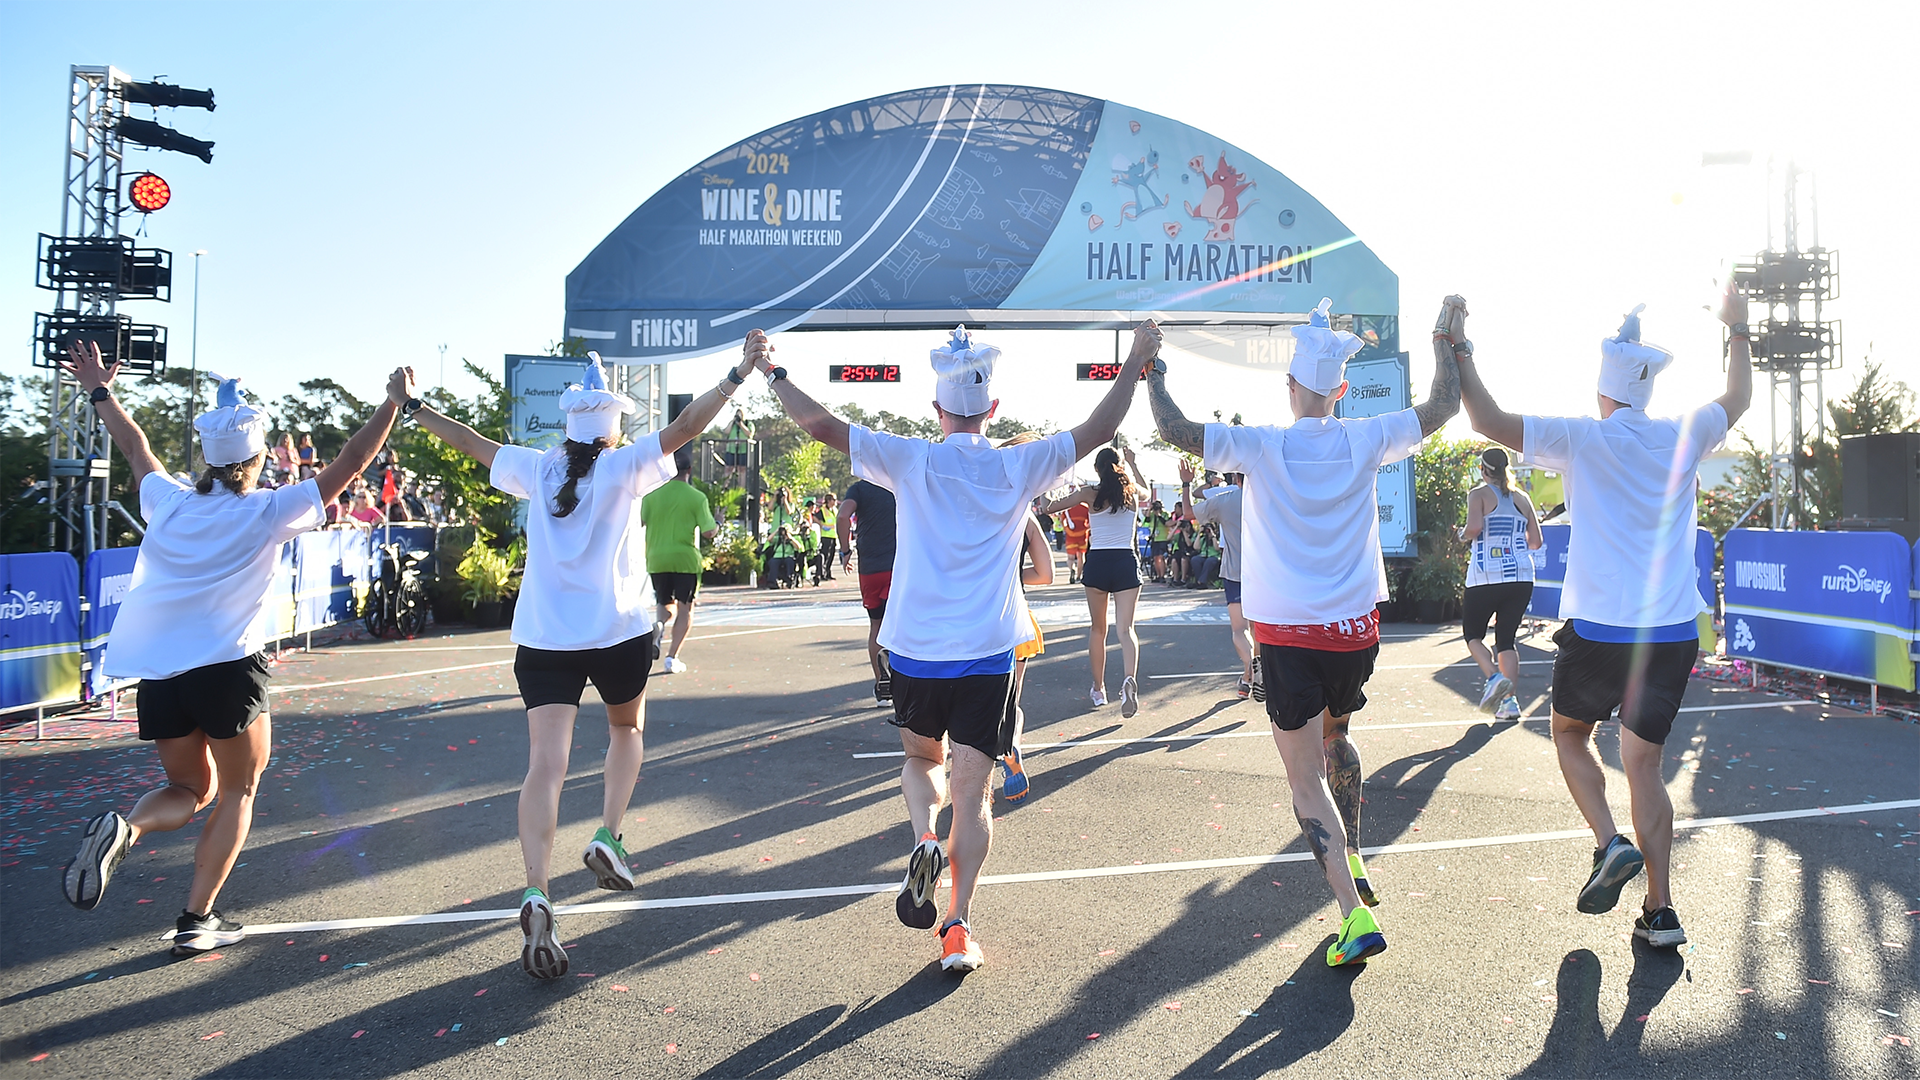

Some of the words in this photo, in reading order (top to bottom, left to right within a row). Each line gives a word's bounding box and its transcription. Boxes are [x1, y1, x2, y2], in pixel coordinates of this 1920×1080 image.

[746, 152, 790, 175] 2024
[701, 173, 735, 188] Disney
[701, 188, 760, 221] WINE
[762, 183, 782, 226] &
[786, 189, 842, 222] DINE
[699, 229, 726, 246] HALF
[728, 229, 789, 246] MARATHON
[791, 229, 842, 247] WEEKEND
[1087, 241, 1153, 281] HALF
[1164, 243, 1313, 284] MARATHON
[1360, 387, 1391, 399] STINGER
[1735, 560, 1787, 592] IMPOSSIBLE
